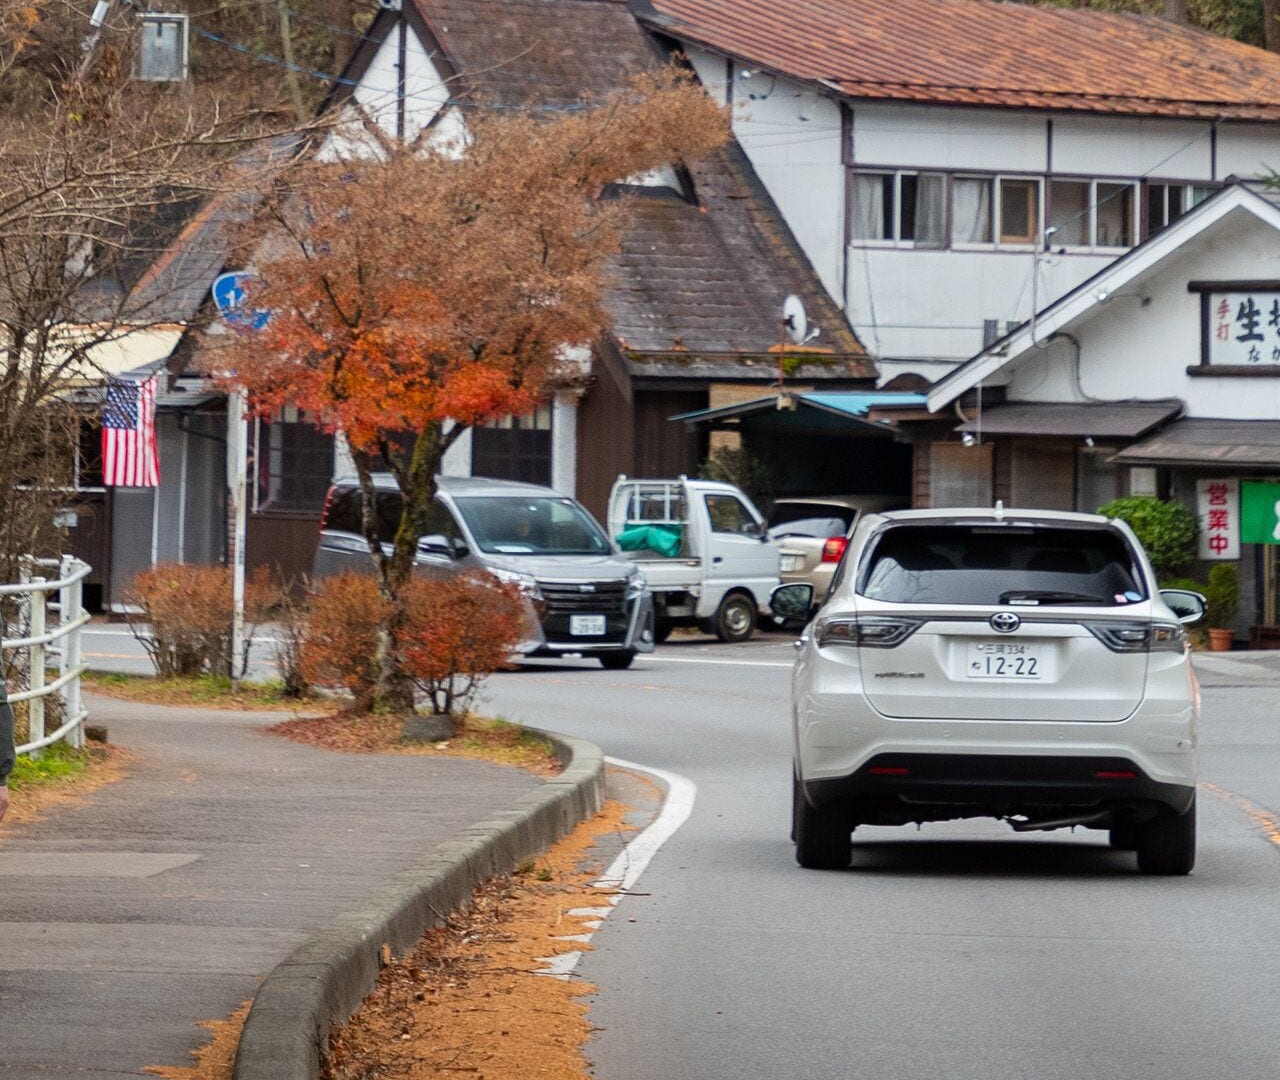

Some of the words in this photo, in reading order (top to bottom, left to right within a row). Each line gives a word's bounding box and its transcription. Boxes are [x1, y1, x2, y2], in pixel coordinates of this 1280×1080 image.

[1207, 483, 1229, 556] 営業中
[986, 656, 1038, 675] 12-22
